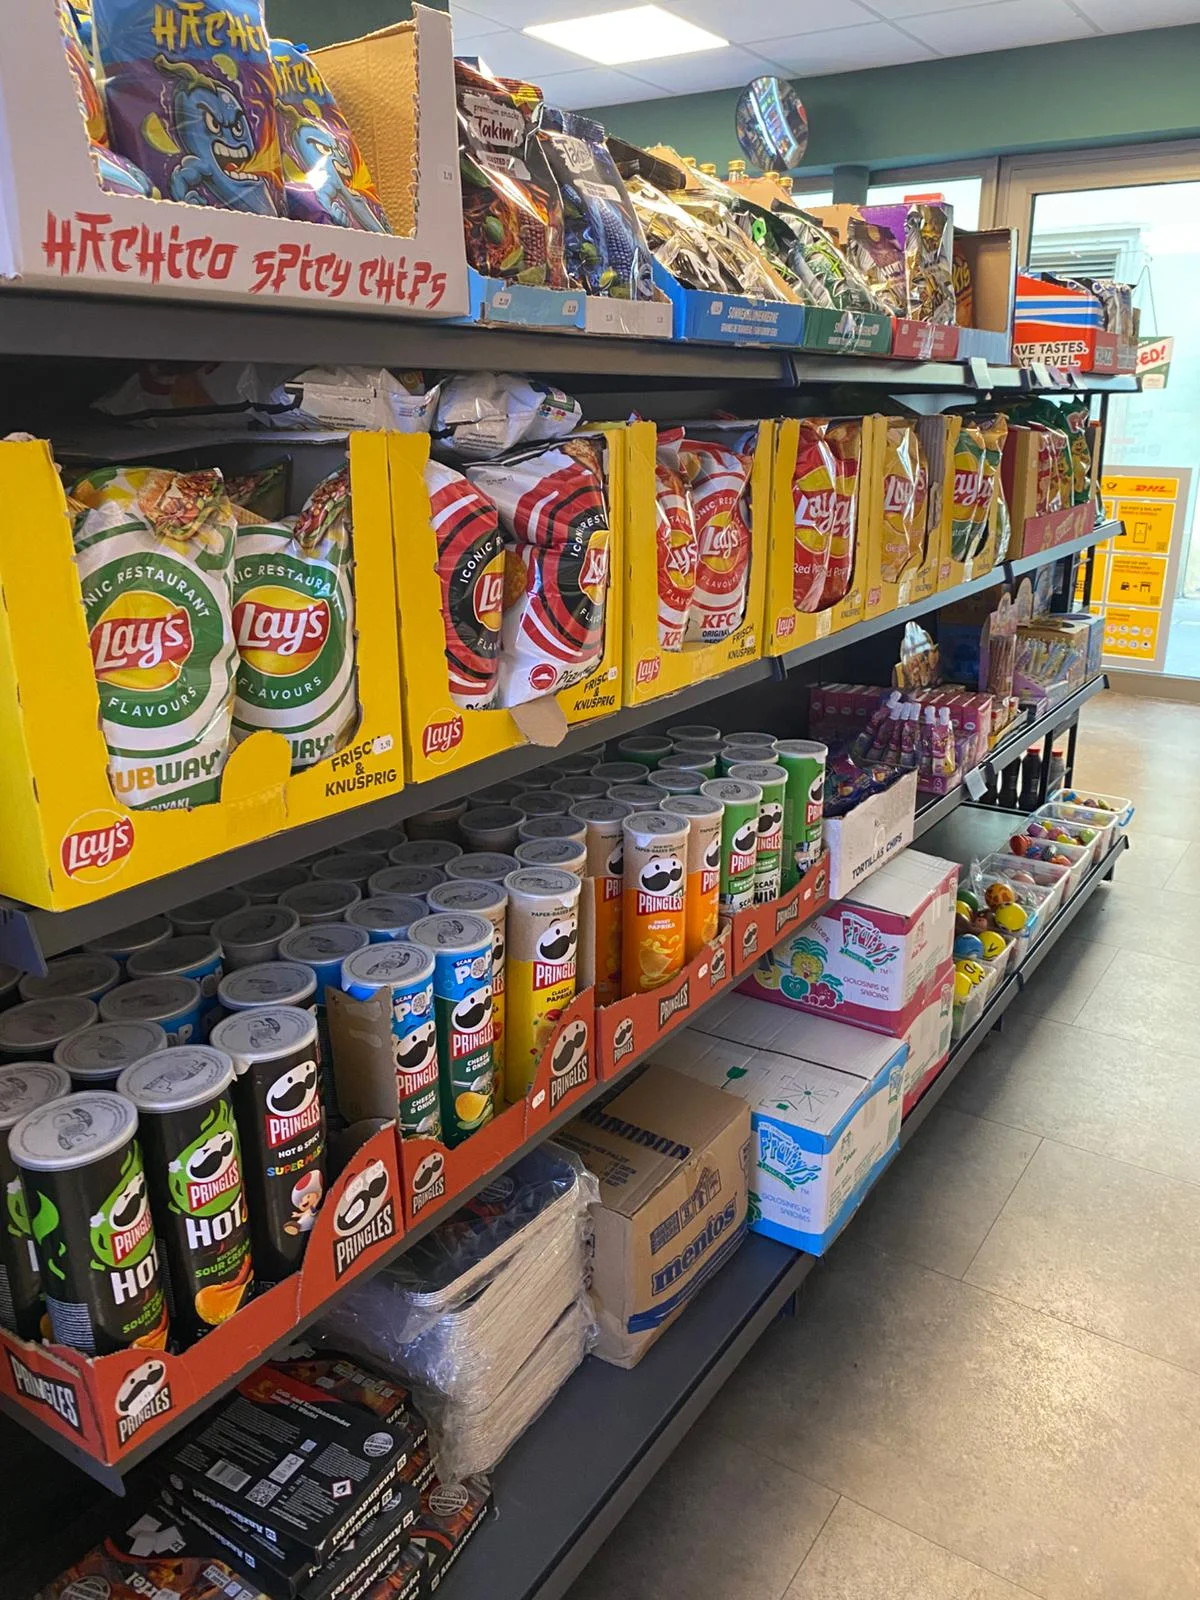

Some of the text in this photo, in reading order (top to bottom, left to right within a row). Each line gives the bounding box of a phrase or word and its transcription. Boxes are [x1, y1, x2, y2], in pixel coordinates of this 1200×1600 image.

[1019, 355, 1033, 367] XT
[1040, 341, 1088, 354] TASTES.
[1136, 345, 1166, 365] ED!
[1135, 484, 1166, 493] DHL
[795, 492, 836, 535] Lay
[571, 521, 587, 557] ICONI
[703, 526, 739, 559] Lay's
[459, 541, 493, 584] ICONIC
[793, 564, 811, 574] Red
[83, 566, 210, 617] NIC RESTAURANT
[239, 604, 324, 656] Lay's
[701, 612, 737, 629] KFC
[732, 624, 755, 644] FRISCH
[777, 616, 796, 637] Lay's
[95, 613, 184, 669] Lay's
[662, 631, 682, 648] KF
[584, 673, 609, 694] FRISC
[637, 656, 660, 682] Lay's
[108, 686, 196, 717] FLAVOURS
[238, 676, 322, 700] FLAVOURS
[593, 690, 600, 698] &
[573, 694, 616, 712] KNUSPRIG
[427, 719, 461, 751] Lay's
[331, 736, 380, 772] FRISC
[114, 749, 221, 793] UBWAY
[325, 769, 397, 797] KNUSPRIG
[355, 763, 365, 775] &
[69, 822, 130, 870] Lay's
[852, 846, 884, 880] TORTILLAS
[886, 832, 903, 852] CHIPS
[754, 879, 774, 889] SCAN
[639, 892, 682, 914] PRINGLES
[811, 921, 831, 943] Bites
[456, 958, 472, 967] SCAN
[395, 994, 412, 1004] SCAN
[660, 981, 688, 1025] PRINGLES
[453, 1022, 493, 1057] PRINGLE
[398, 1061, 439, 1096] PRINGLE
[551, 1065, 588, 1107] PRINGLES
[269, 1104, 320, 1145] PRINGLES
[267, 1159, 305, 1177] SUPER
[279, 1149, 296, 1159] HOT
[190, 1159, 239, 1209] PRINGLES
[413, 1175, 444, 1215] PRINGLES
[186, 1193, 243, 1250] HOT
[336, 1203, 393, 1273] PRINGLES
[653, 1198, 736, 1294] mentos
[195, 1260, 226, 1278] SOUR
[123, 1311, 149, 1334] SOUR
[10, 1355, 79, 1428] PRINGLES
[119, 1386, 171, 1443] PRINGLES
